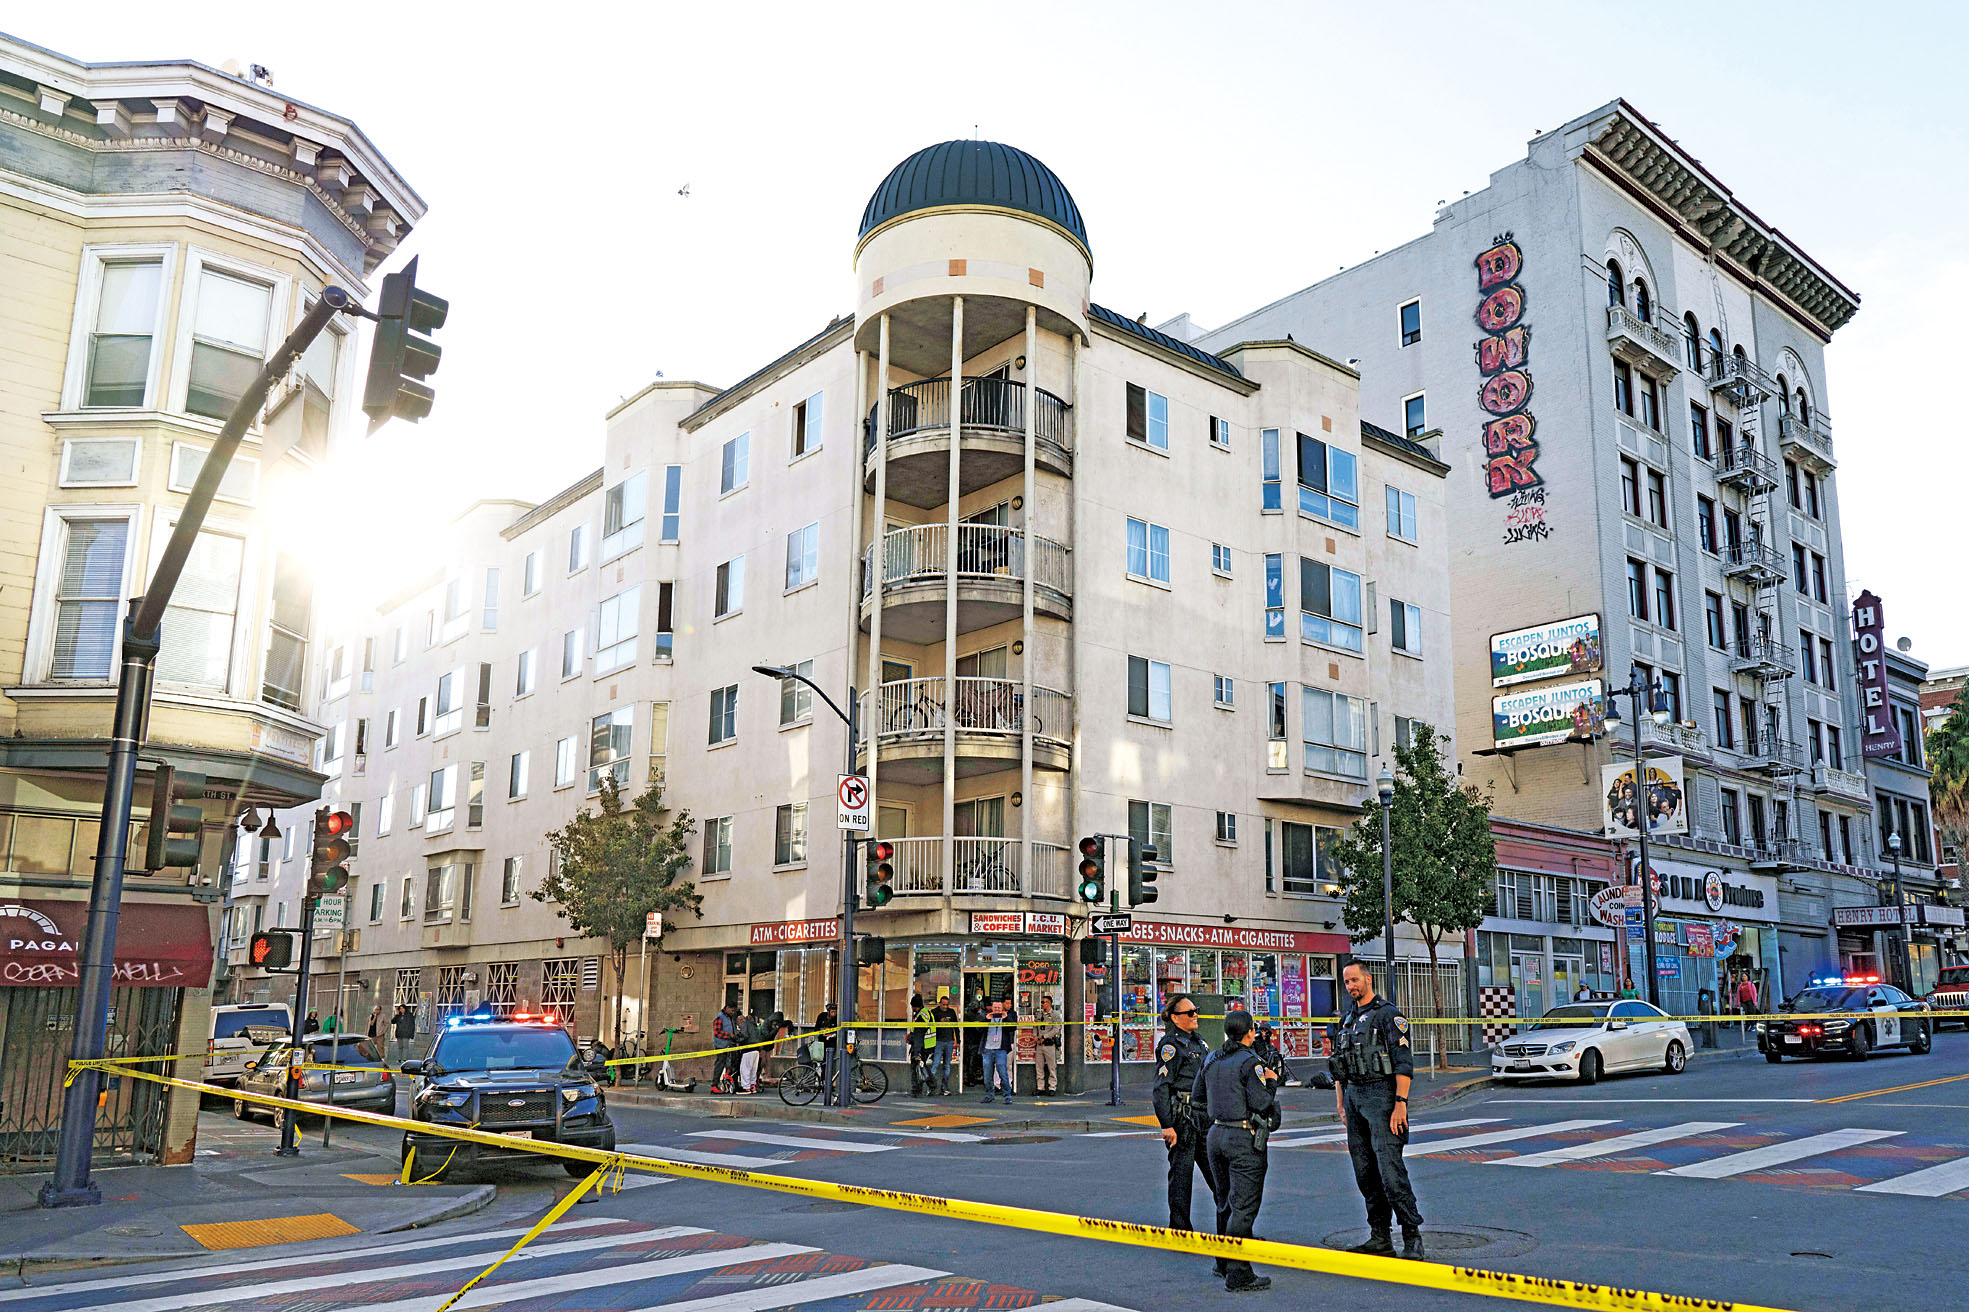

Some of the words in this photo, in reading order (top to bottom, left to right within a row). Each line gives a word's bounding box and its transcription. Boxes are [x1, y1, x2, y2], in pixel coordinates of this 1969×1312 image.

[1499, 632, 1543, 649] ESCAPEN
[1548, 622, 1589, 642] JUNTOS
[1857, 606, 1886, 735] HOTEL
[1502, 694, 1546, 711] ESCAPEN
[1551, 686, 1592, 702] JUNTOS
[1865, 740, 1895, 752] HENRY
[840, 814, 850, 823] ON
[852, 814, 866, 824] RED
[1600, 910, 1624, 926] WASH
[1837, 908, 1874, 924] HENRY
[974, 923, 982, 931] &
[983, 923, 1020, 931] COFFEE
[1028, 924, 1062, 934] MARKET
[1103, 920, 1114, 928] ONE
[1116, 918, 1128, 927] WAY
[752, 927, 772, 942] ATM
[778, 921, 836, 940] CIGARETTES
[1160, 926, 1204, 942] SNACKS
[1210, 930, 1233, 944] ATM
[1239, 931, 1294, 948] CIGARETTES
[1655, 932, 1676, 944] RODUCE
[10, 940, 78, 950] PAGA
[1028, 961, 1050, 969] Open
[1018, 970, 1058, 983] Deli
